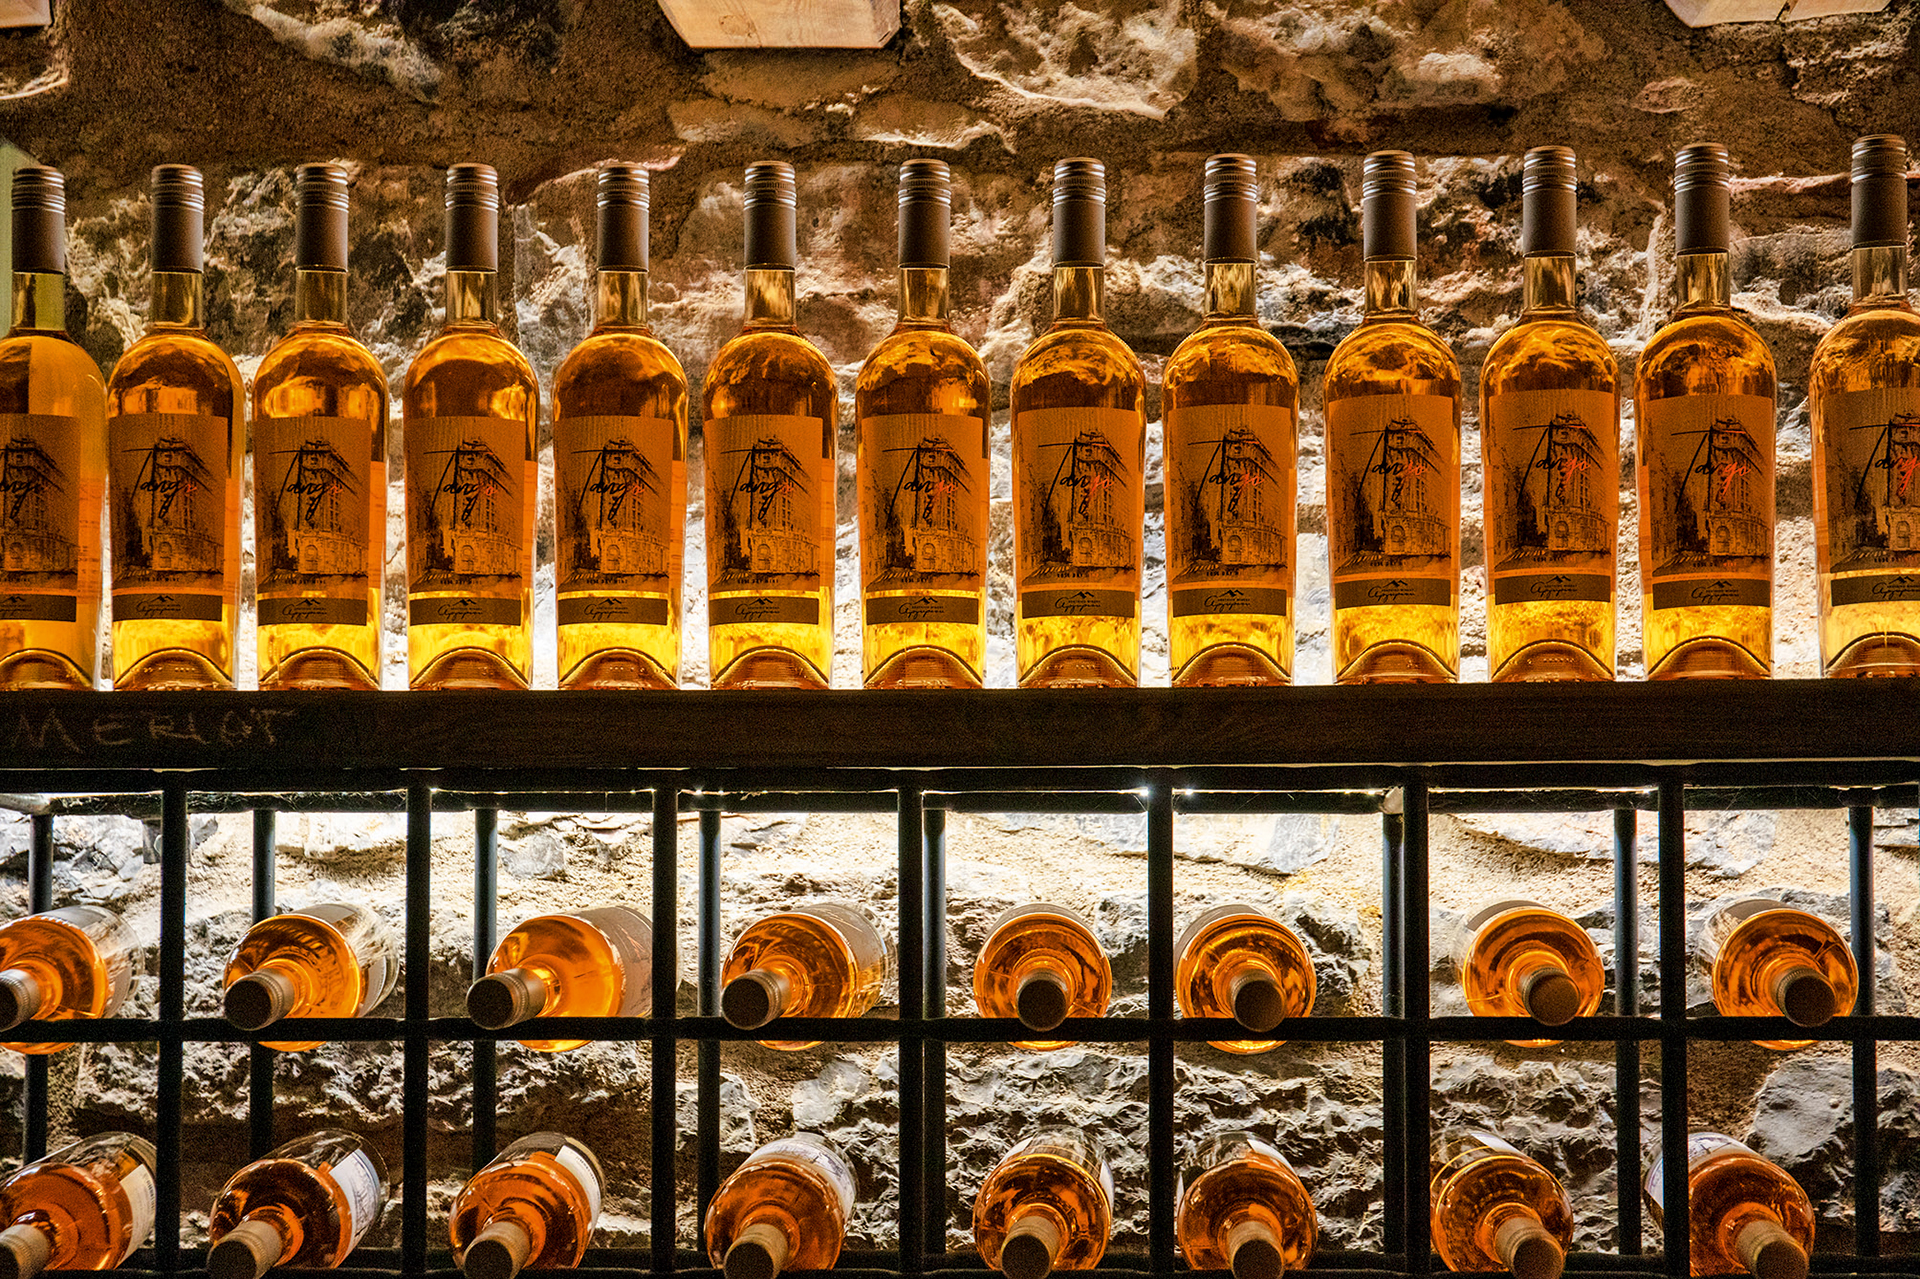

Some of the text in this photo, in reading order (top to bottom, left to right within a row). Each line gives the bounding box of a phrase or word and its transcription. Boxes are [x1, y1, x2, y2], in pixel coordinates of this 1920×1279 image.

[121, 445, 197, 525] Tango
[268, 447, 344, 527] Tango
[423, 446, 498, 527] Tango
[571, 447, 645, 528] Tango
[721, 446, 794, 527] Tango
[883, 445, 957, 527] Tango
[1038, 438, 1112, 524] Tango
[1187, 436, 1264, 519] Tango
[1349, 427, 1428, 511] Tango
[1512, 421, 1590, 508] Tango
[1671, 426, 1751, 513] Tango
[11, 707, 298, 752] MERLOT
